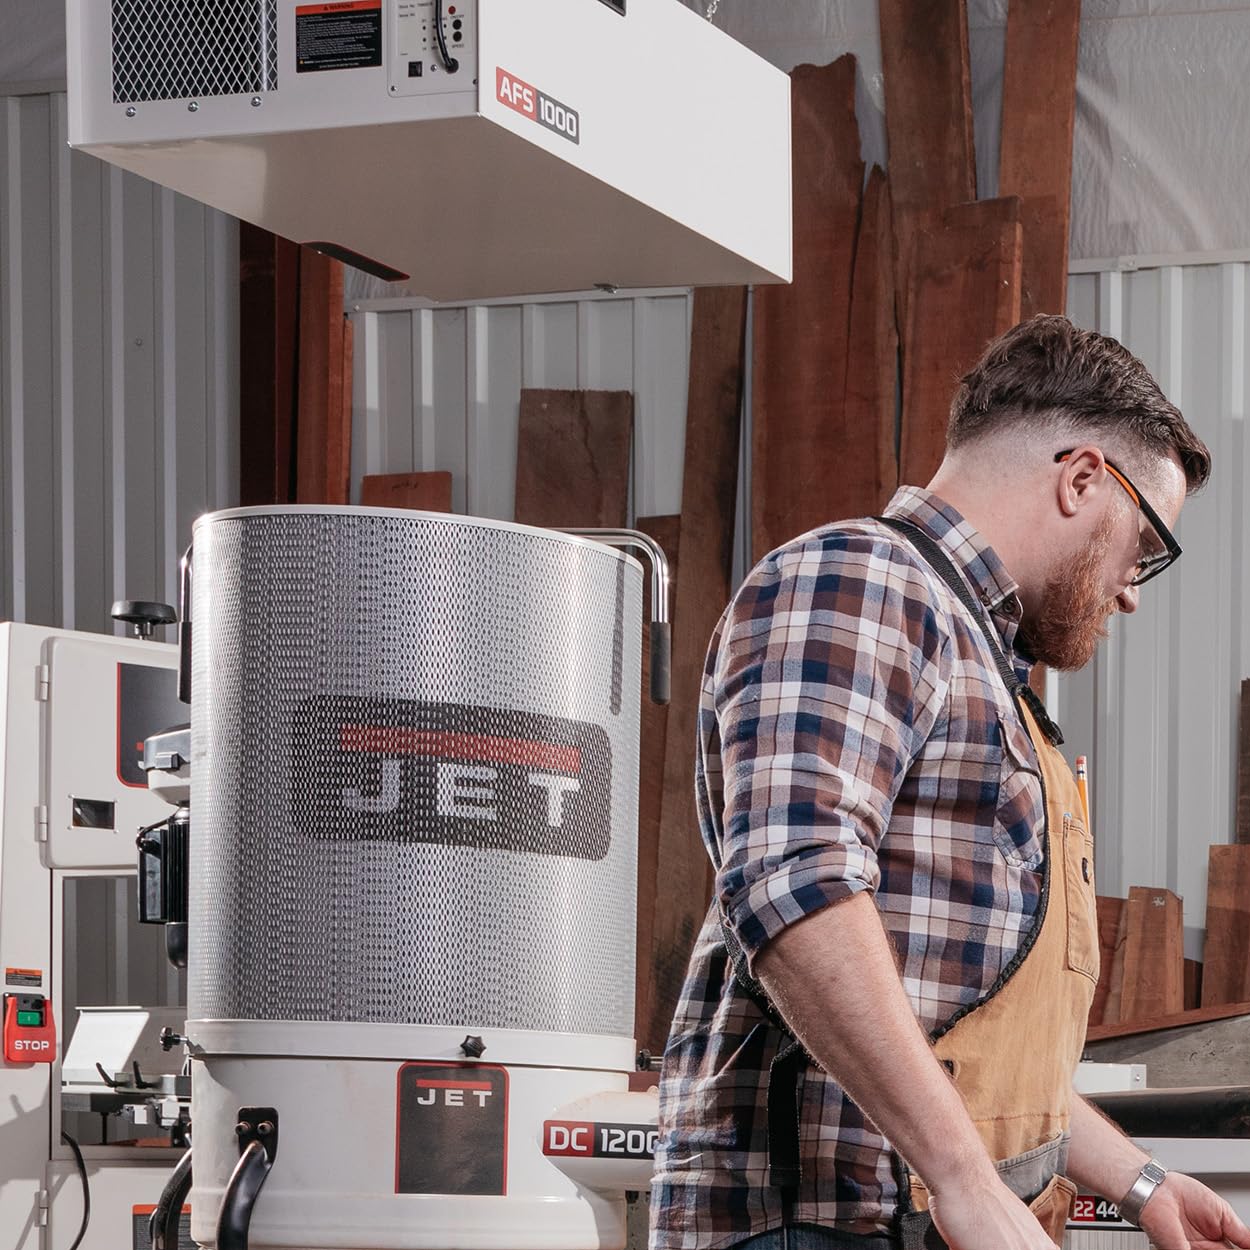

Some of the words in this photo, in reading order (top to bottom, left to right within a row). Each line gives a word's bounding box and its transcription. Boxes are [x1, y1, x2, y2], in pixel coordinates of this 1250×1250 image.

[500, 76, 534, 113] AFS
[540, 96, 577, 137] 1000
[342, 759, 580, 827] JET
[15, 1040, 49, 1050] STOP
[417, 1089, 492, 1107] JET
[550, 1127, 588, 1151] DC
